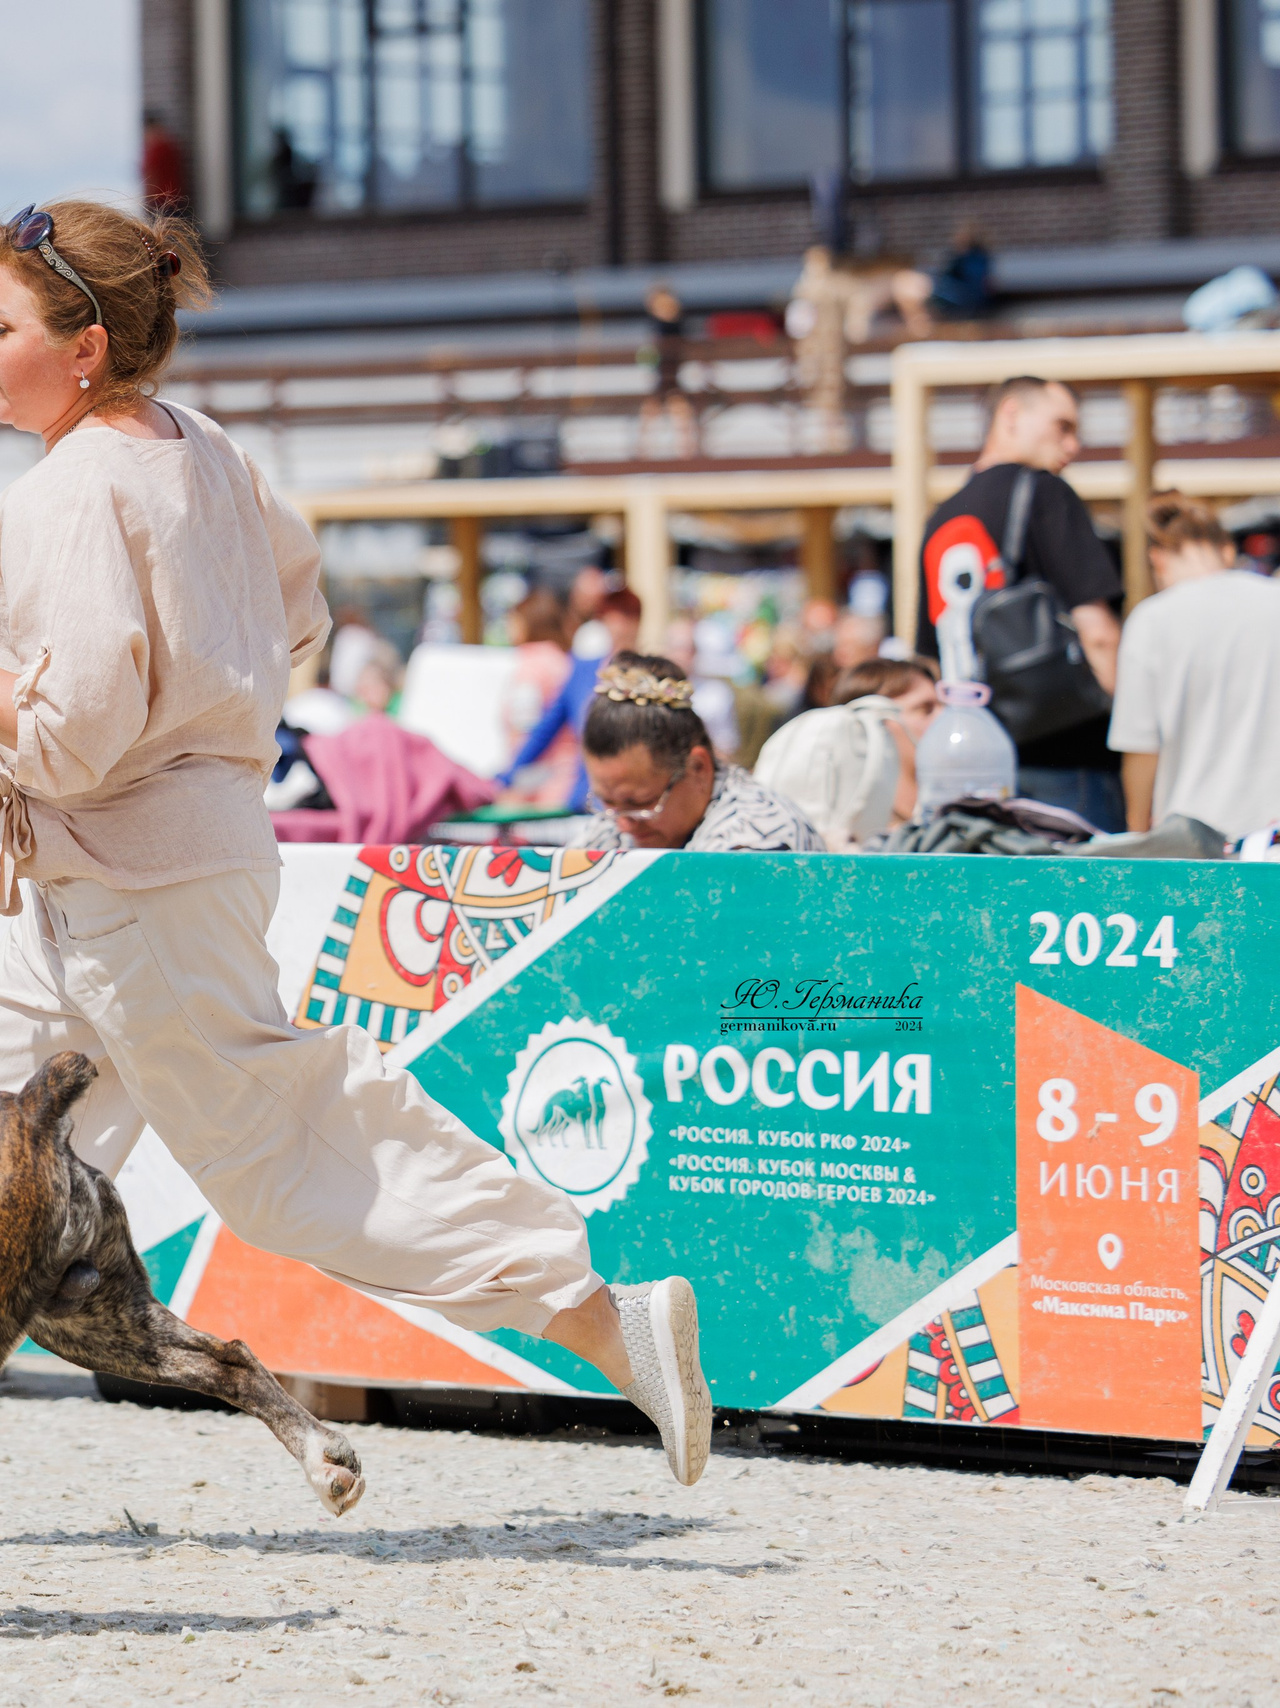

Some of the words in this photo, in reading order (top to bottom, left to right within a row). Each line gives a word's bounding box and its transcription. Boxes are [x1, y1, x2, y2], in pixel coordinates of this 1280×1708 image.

[1029, 911, 1179, 968] 2024
[663, 1044, 931, 1115] РОССИЯ
[669, 1125, 753, 1145] «РОССИЯ.
[758, 1130, 816, 1148] КУБОК
[820, 1133, 857, 1150] РКФ
[861, 1135, 911, 1152] 2024»
[669, 1154, 753, 1174] «РОССИЯ.
[758, 1158, 816, 1177] КУБОК
[820, 1161, 899, 1182] МОСКВЫ
[903, 1166, 917, 1183] &
[1039, 1161, 1179, 1204] ИЮНЯ
[669, 1175, 725, 1194] КУБОК
[729, 1178, 882, 1203] ГОРОДОВ-ГЕРОЕВ
[886, 1187, 936, 1205] 2024»
[1030, 1274, 1120, 1294] Московская
[1031, 1296, 1125, 1319] «Максима
[1129, 1301, 1189, 1327] Парк»
